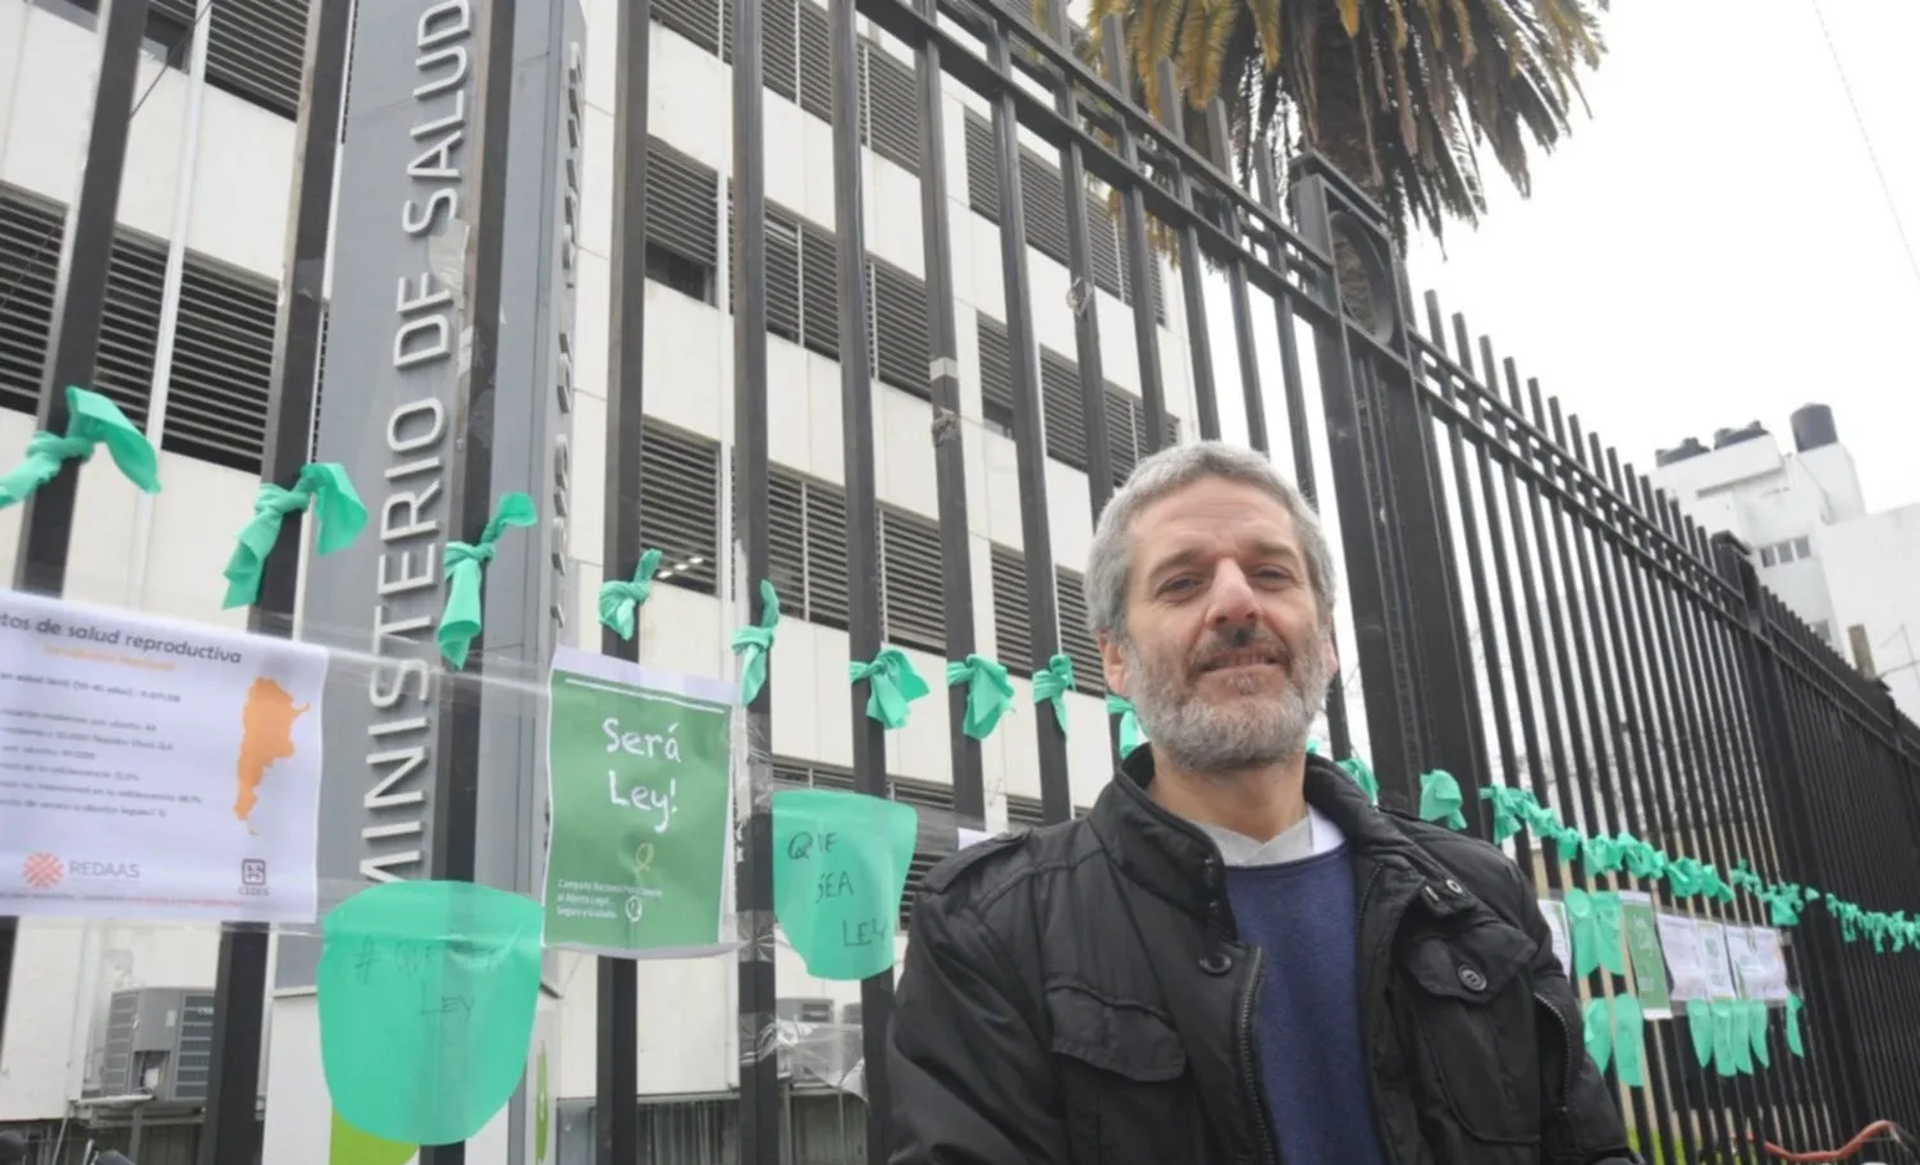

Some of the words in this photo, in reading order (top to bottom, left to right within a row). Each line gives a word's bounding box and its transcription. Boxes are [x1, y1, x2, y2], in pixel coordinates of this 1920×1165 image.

[402, 0, 472, 237] SALUD
[393, 271, 454, 369] DE
[36, 617, 62, 636] de
[67, 625, 119, 645] salud
[125, 636, 242, 664] reproductiva
[602, 717, 682, 763] Será
[608, 769, 679, 833] Ley!
[69, 861, 141, 879] REDAAS
[842, 918, 888, 948] LEY
